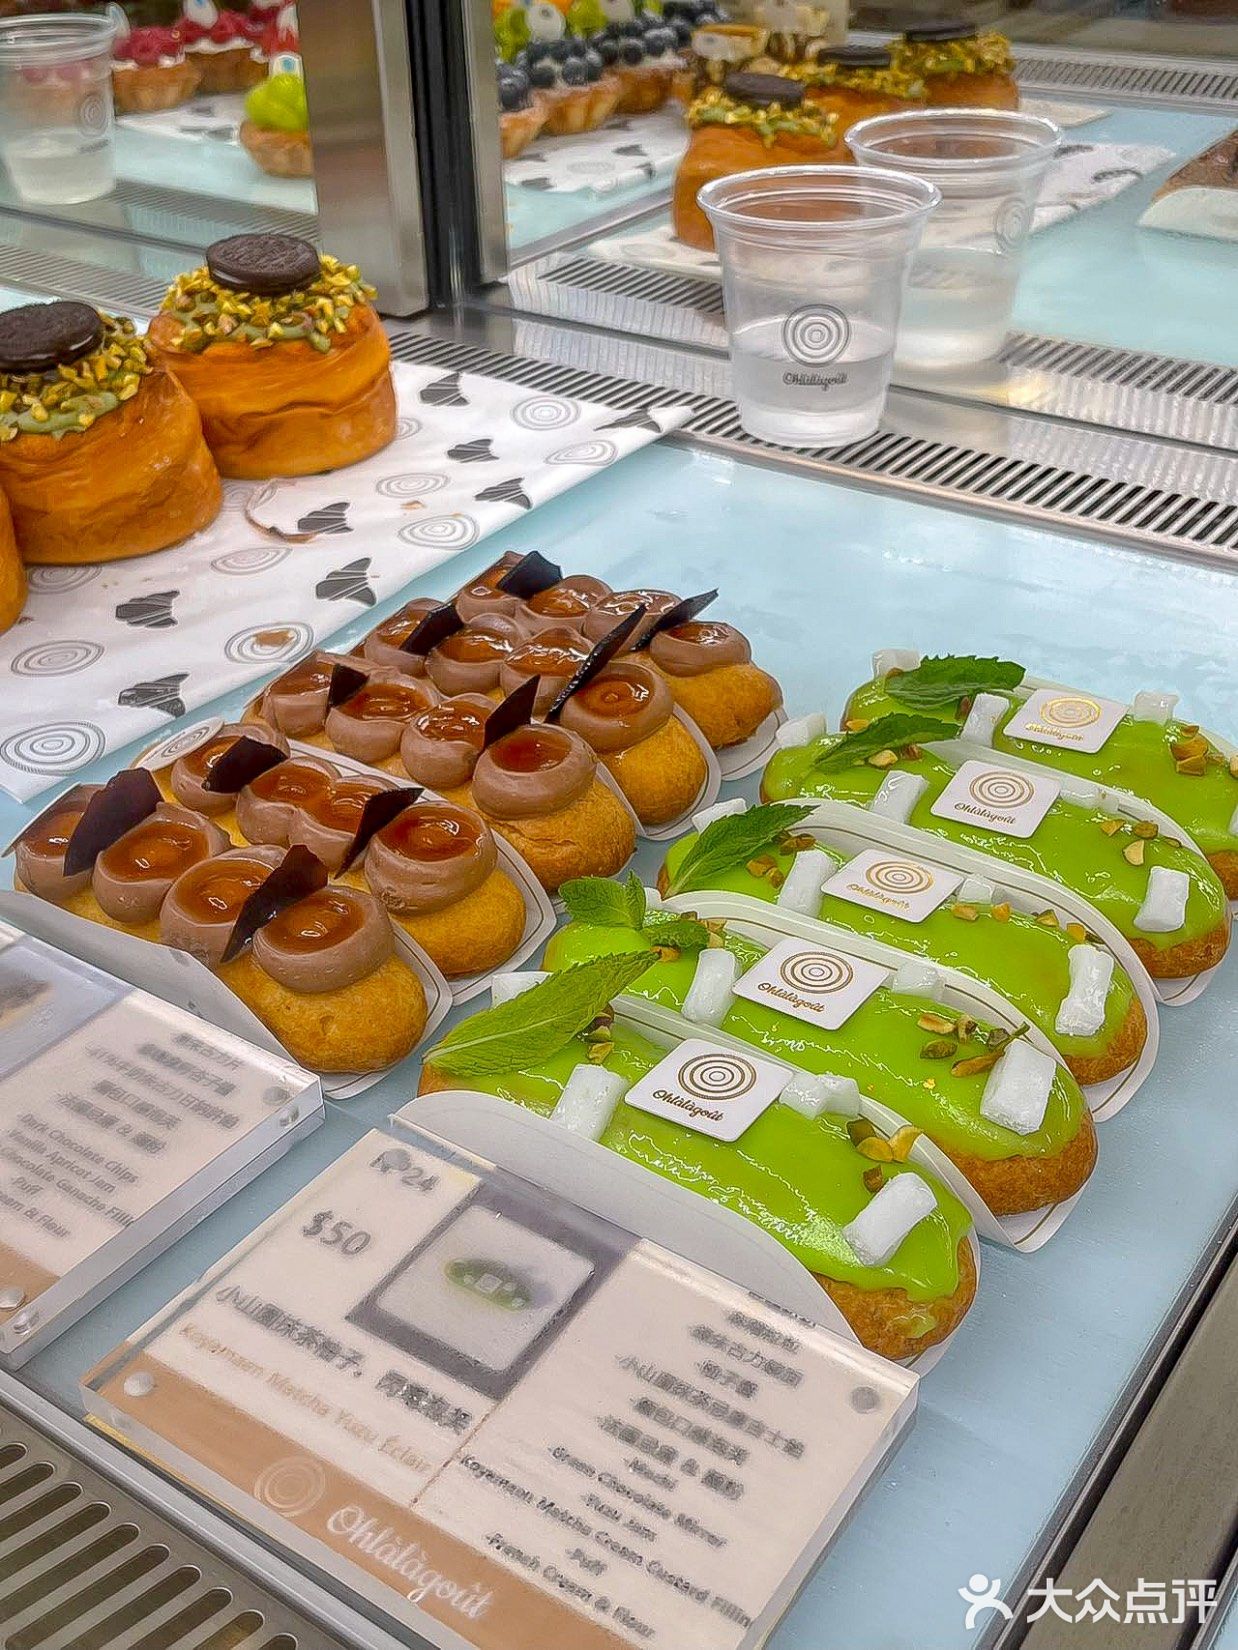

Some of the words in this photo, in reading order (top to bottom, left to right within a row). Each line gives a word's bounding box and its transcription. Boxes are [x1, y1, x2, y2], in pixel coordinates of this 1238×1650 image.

[652, 1089, 724, 1122] Ohlàlàgoût
[115, 1124, 133, 1136] &
[44, 1150, 92, 1180] Apricot
[87, 1175, 116, 1194] Jam
[103, 1160, 139, 1184] Chips
[302, 1210, 372, 1256] $50
